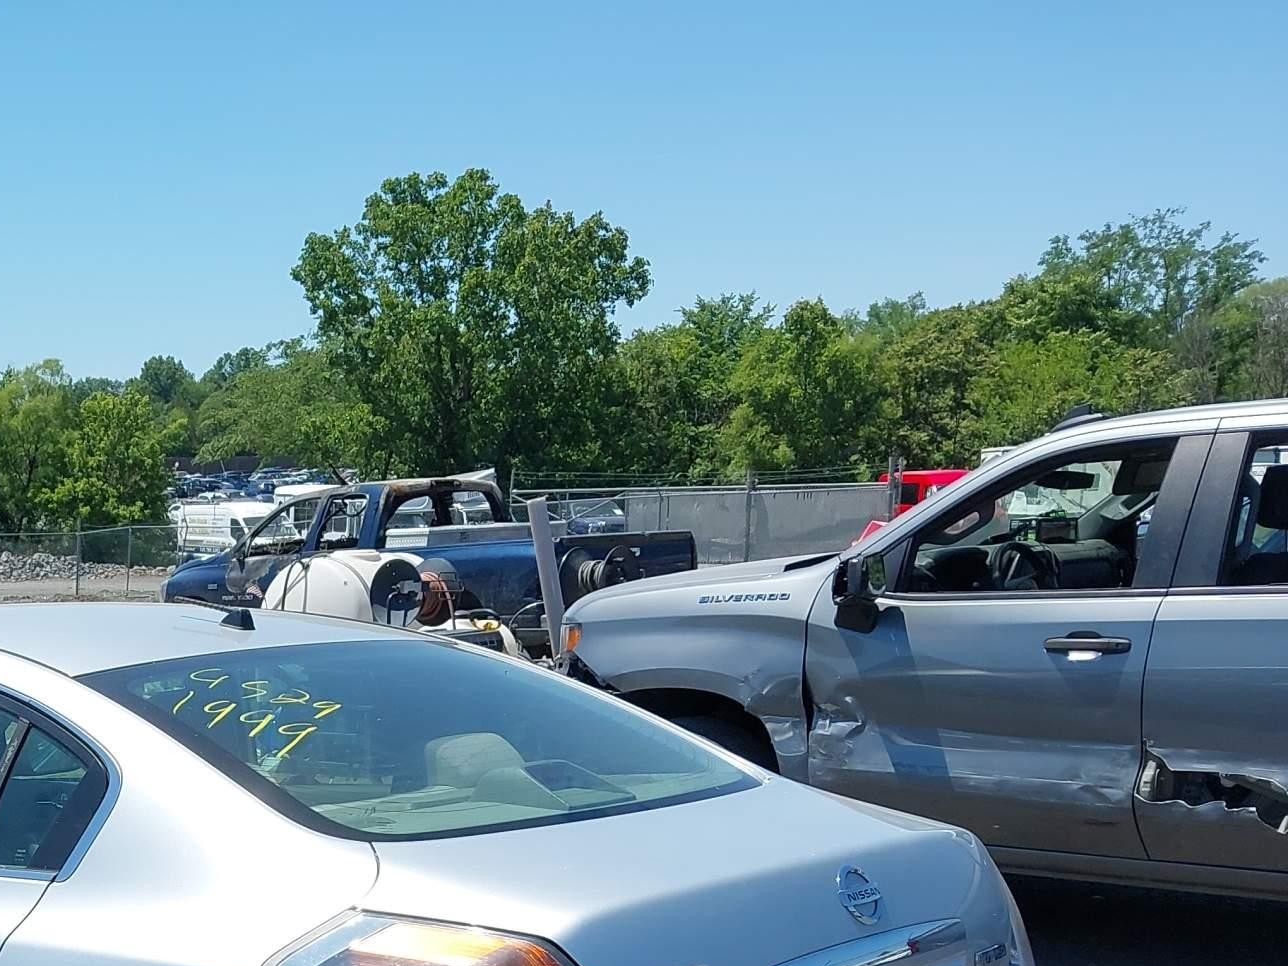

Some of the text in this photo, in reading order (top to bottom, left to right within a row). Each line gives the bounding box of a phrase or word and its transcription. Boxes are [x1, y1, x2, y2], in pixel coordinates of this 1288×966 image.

[698, 593, 791, 604] SILVERADO
[172, 690, 318, 759] 1999
[847, 887, 881, 903] NISSAN
